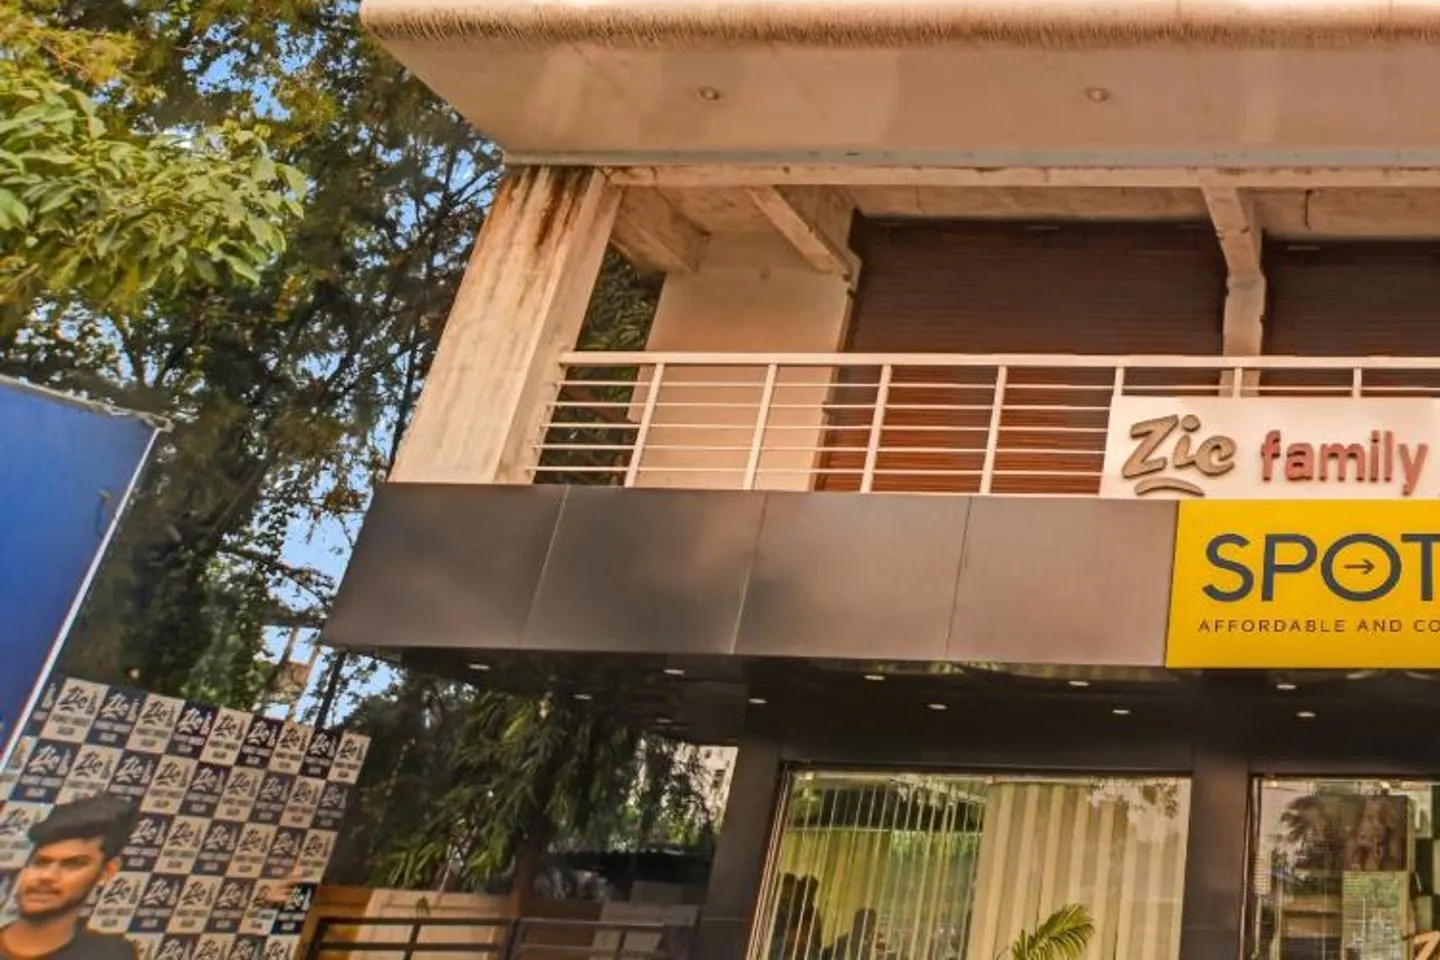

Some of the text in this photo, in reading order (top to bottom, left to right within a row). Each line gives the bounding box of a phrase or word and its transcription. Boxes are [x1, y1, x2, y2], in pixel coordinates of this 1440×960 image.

[1261, 430, 1429, 495] family
[1198, 618, 1346, 633] AFFORDABLE
[1356, 618, 1403, 633] AND
